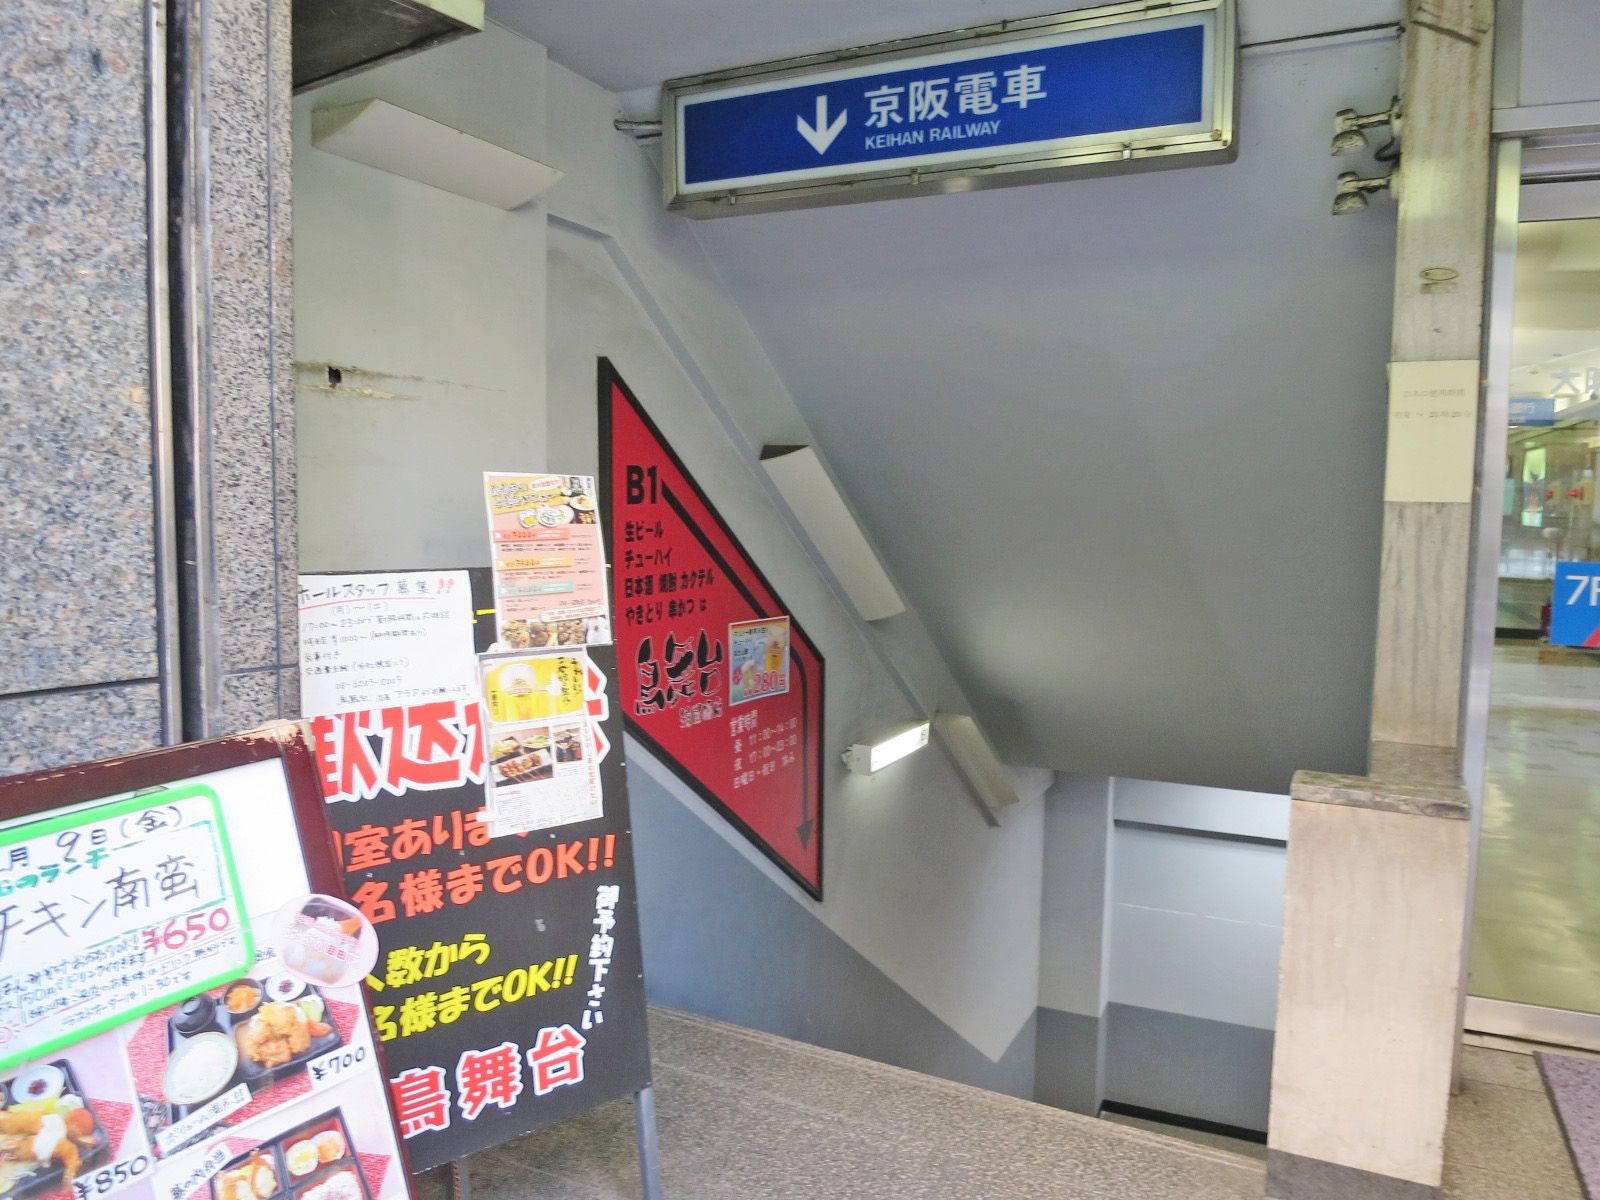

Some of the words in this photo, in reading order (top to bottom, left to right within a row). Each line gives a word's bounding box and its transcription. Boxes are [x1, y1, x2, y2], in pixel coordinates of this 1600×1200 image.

[864, 64, 1048, 129] 京阪電車
[864, 130, 924, 151] KEIHAN
[929, 119, 1002, 143] RAILWAY
[626, 465, 657, 504] B1
[625, 521, 664, 543] 生ビール
[625, 548, 673, 569] チューハイ
[681, 569, 714, 589] カクテル
[625, 603, 663, 626] やきとり
[142, 907, 231, 954] ¥650
[312, 1046, 366, 1081] ¥700
